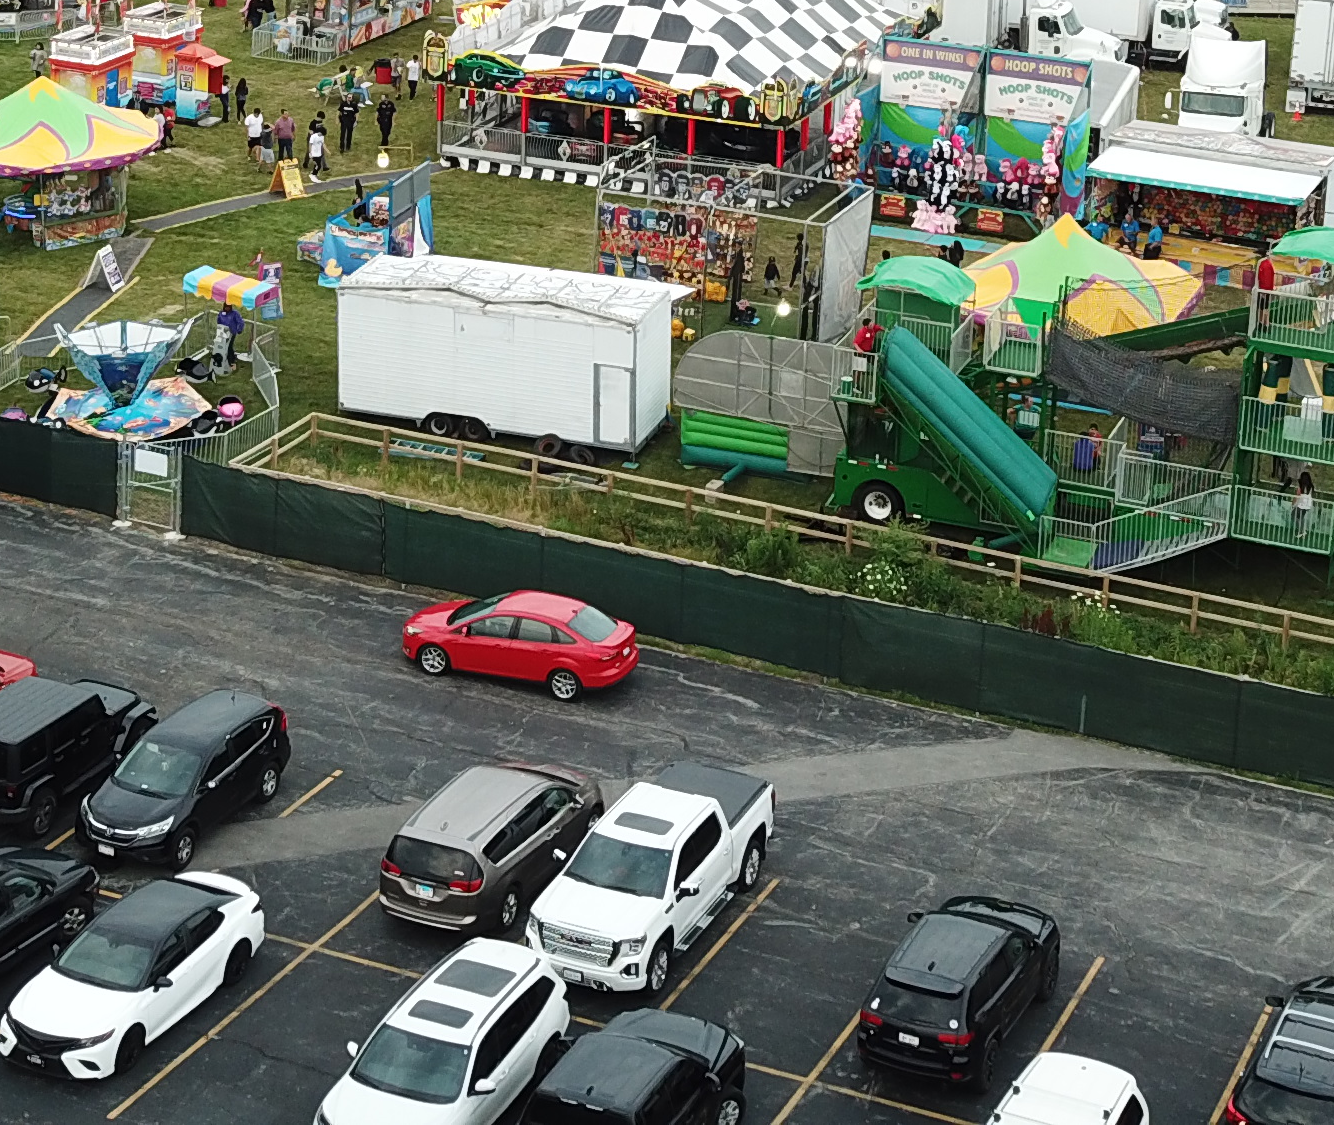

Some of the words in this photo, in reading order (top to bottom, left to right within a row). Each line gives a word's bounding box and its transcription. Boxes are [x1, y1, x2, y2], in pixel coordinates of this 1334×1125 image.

[1005, 59, 1036, 73] HOOP
[1039, 63, 1073, 79] SHOTS
[892, 70, 925, 83] HOOP
[928, 70, 966, 90] SHOTS
[999, 83, 1032, 96] HOOP
[1034, 85, 1075, 105] SHOTS
